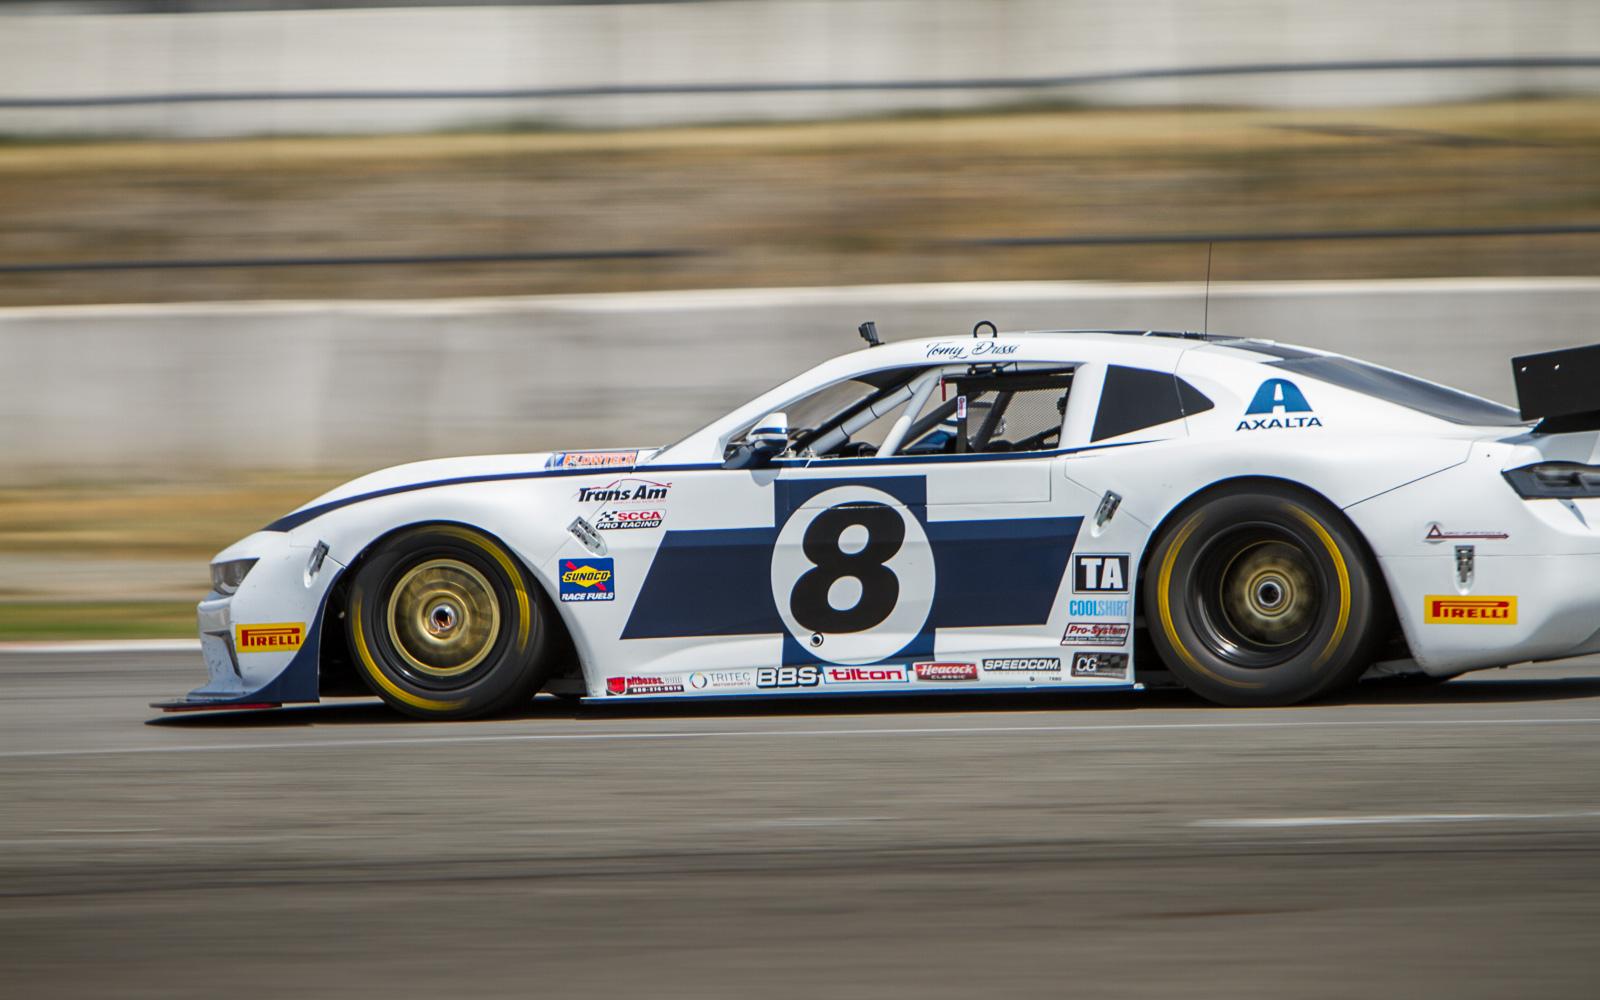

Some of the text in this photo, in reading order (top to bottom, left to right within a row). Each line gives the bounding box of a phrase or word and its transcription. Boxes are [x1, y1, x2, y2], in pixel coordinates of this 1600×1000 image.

[926, 341, 967, 360] Tomy
[1236, 417, 1322, 431] AXALTA
[578, 485, 667, 502] Trans Am
[617, 511, 661, 521] SCCA
[597, 520, 659, 529] PRO RACING
[789, 500, 906, 634] 8
[1080, 557, 1124, 589] TA
[564, 571, 609, 582] SUNOCO
[561, 592, 614, 601] RACE FUELS
[1069, 600, 1128, 616] COOLSHIRT
[1432, 600, 1509, 618] PIRELLI
[241, 627, 300, 647] PIRELLI
[1068, 624, 1127, 637] Pro-System
[919, 664, 974, 675] Heacock
[984, 659, 1059, 670] SPEEDCOM
[1076, 657, 1097, 672] CG
[710, 672, 751, 682] TRITEC
[757, 667, 819, 688] BBS
[828, 669, 902, 681] tilton
